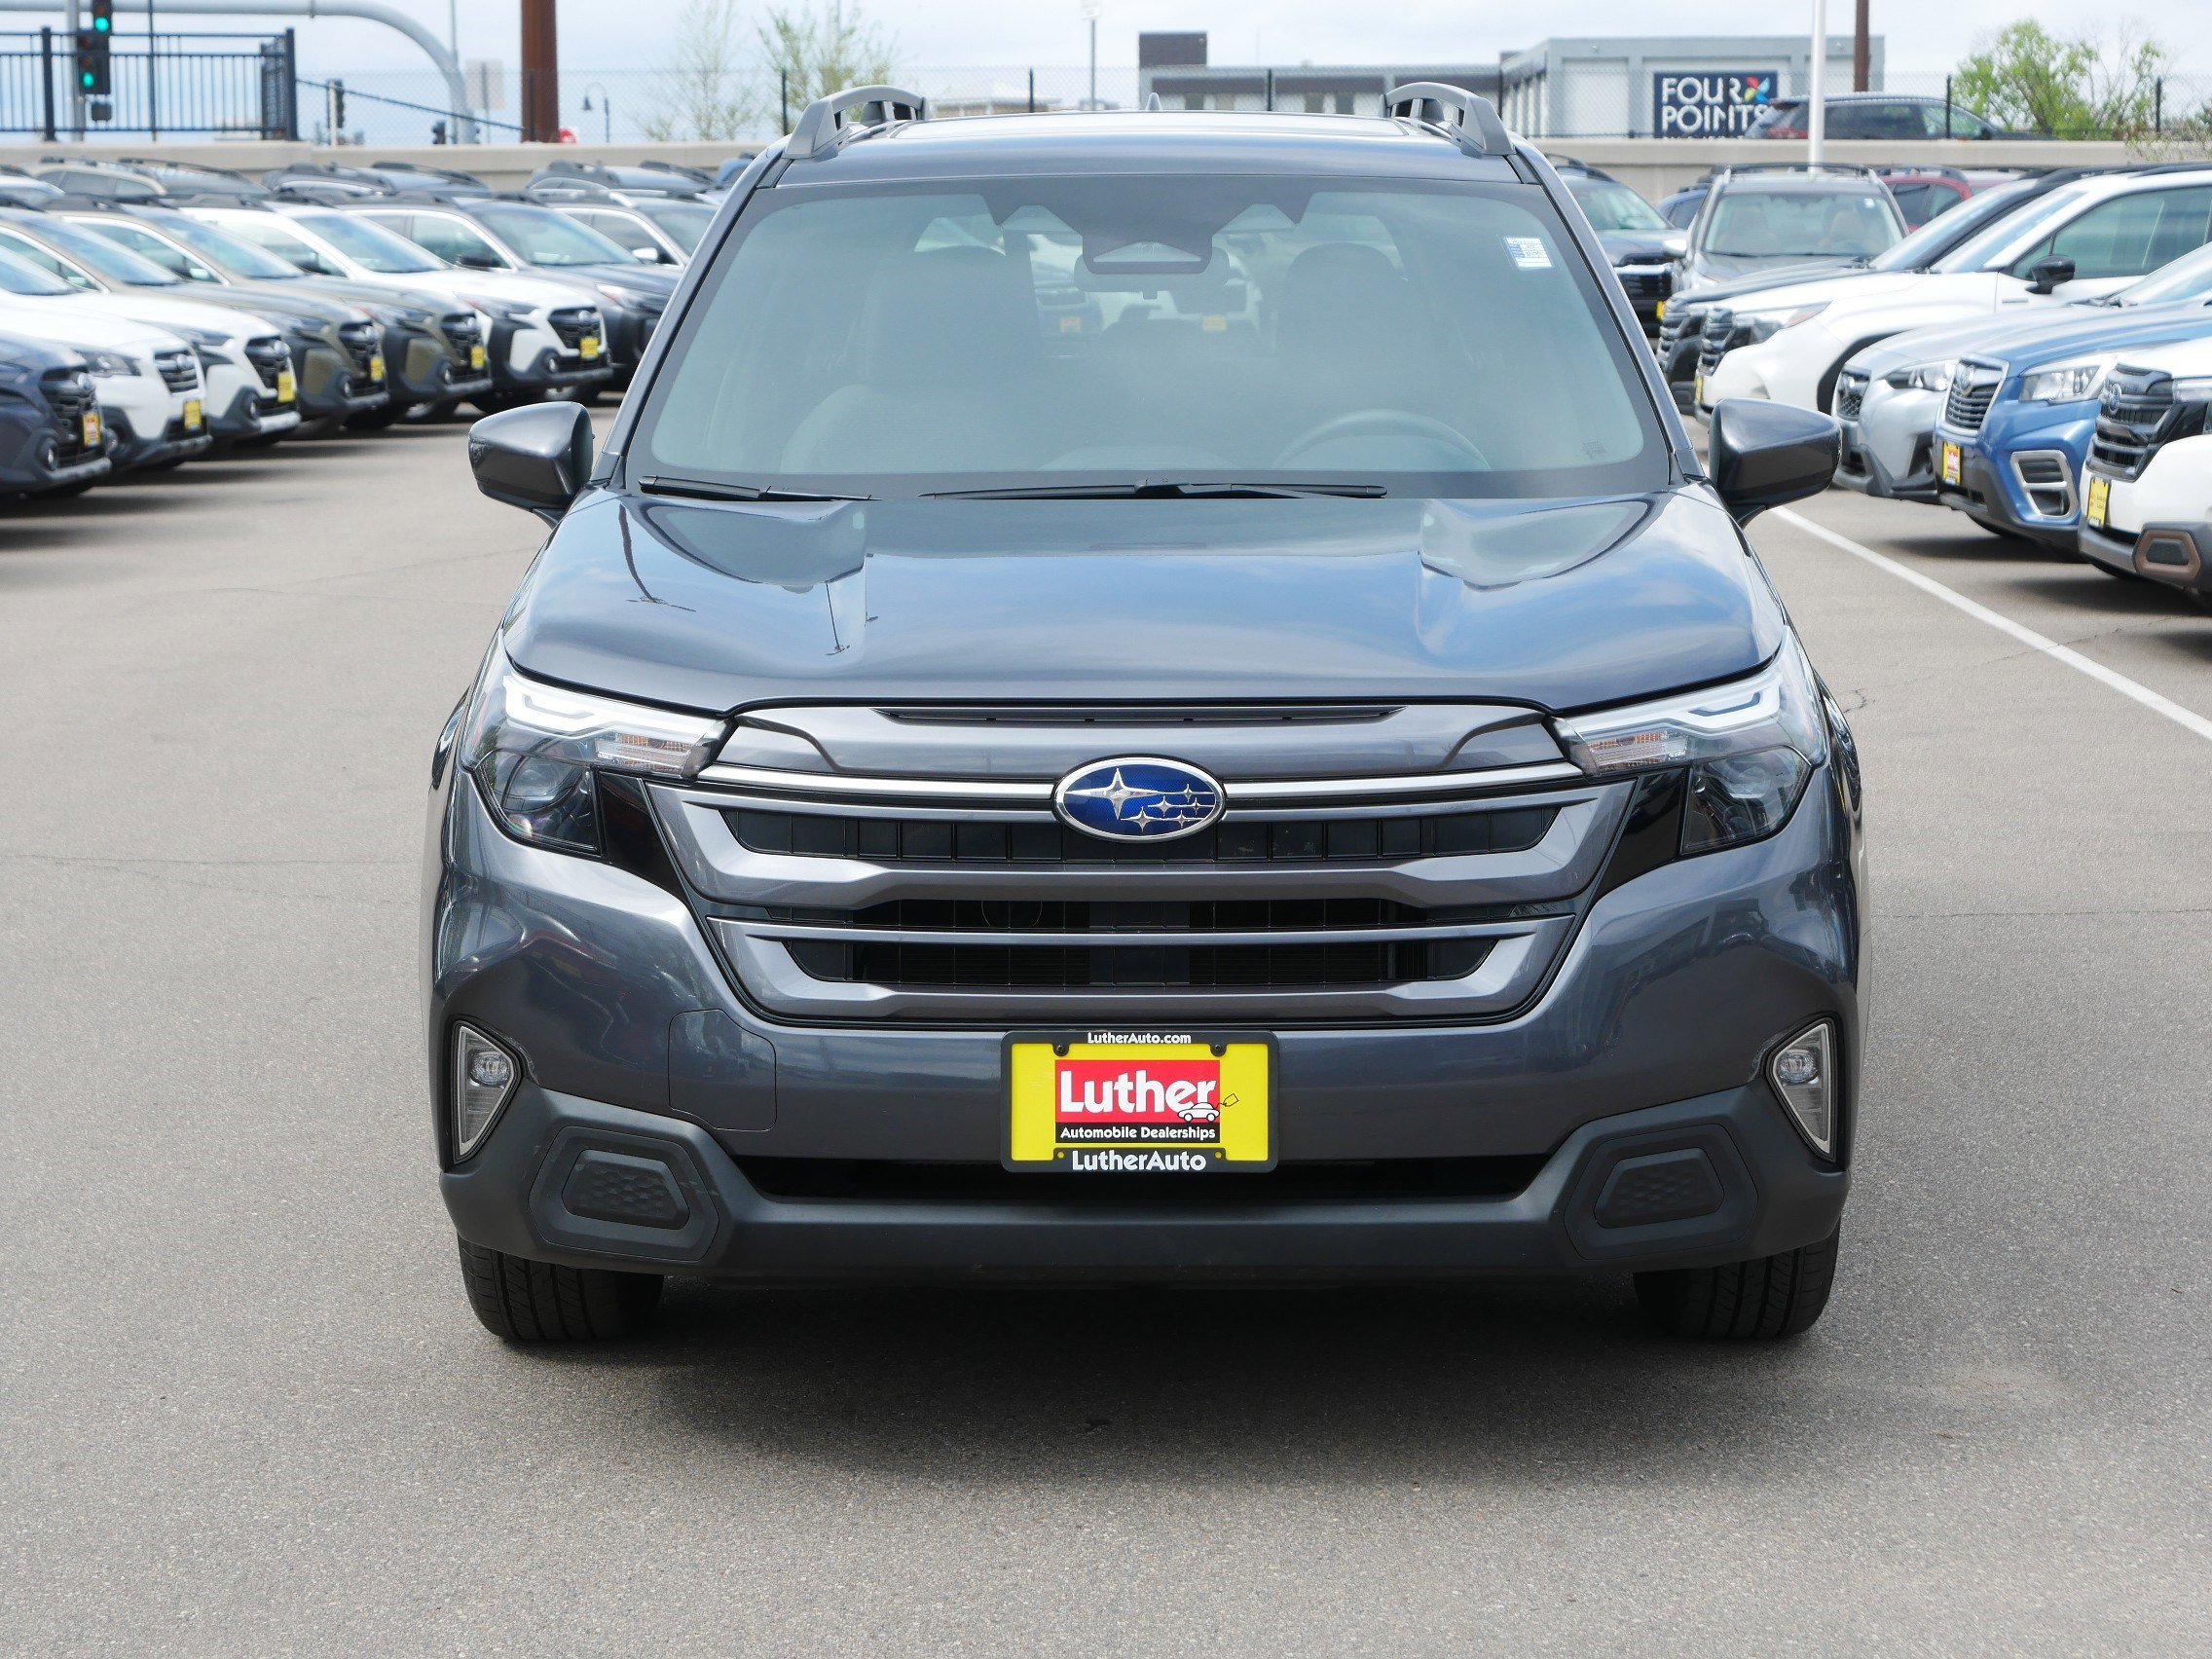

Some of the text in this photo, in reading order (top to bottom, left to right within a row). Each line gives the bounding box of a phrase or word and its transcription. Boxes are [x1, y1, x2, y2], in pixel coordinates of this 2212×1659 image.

[1661, 76, 1744, 105] FOUR
[1088, 1032, 1192, 1044] LutherAuto.com
[1060, 1070, 1217, 1114] Luther
[1059, 1126, 1216, 1141] Automobile Dealerships
[1072, 1150, 1207, 1171] LutherAuto
